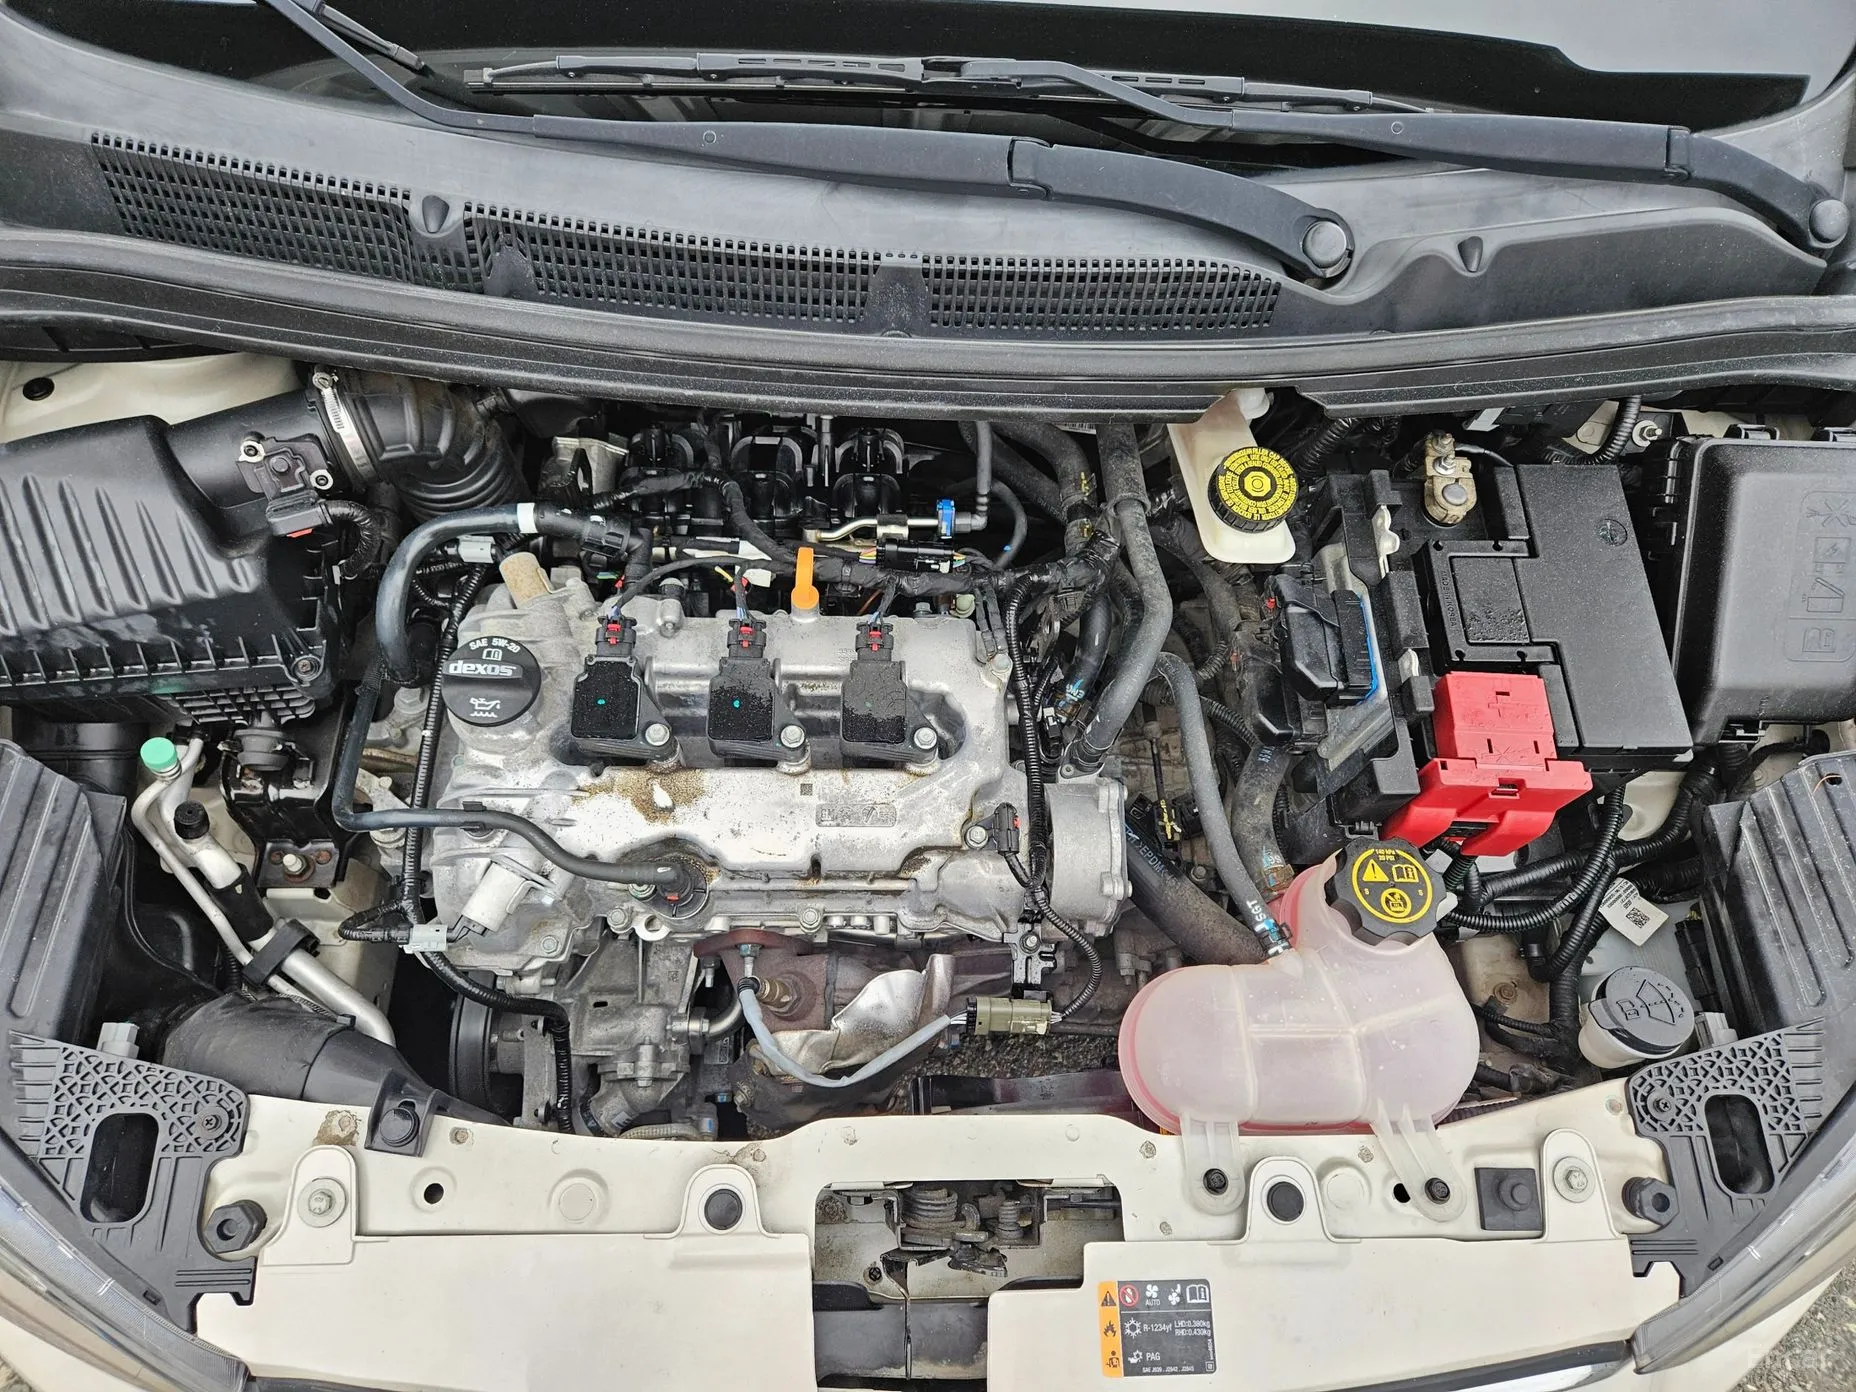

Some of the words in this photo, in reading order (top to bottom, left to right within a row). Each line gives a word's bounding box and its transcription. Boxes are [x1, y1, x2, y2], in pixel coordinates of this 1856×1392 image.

[469, 638, 488, 650] SAE
[492, 638, 521, 653] 5W-20
[449, 660, 517, 677] dexos
[1145, 1298, 1161, 1306] AUTO
[1143, 1322, 1172, 1333] R-1234yf
[1146, 1352, 1161, 1361] PAG
